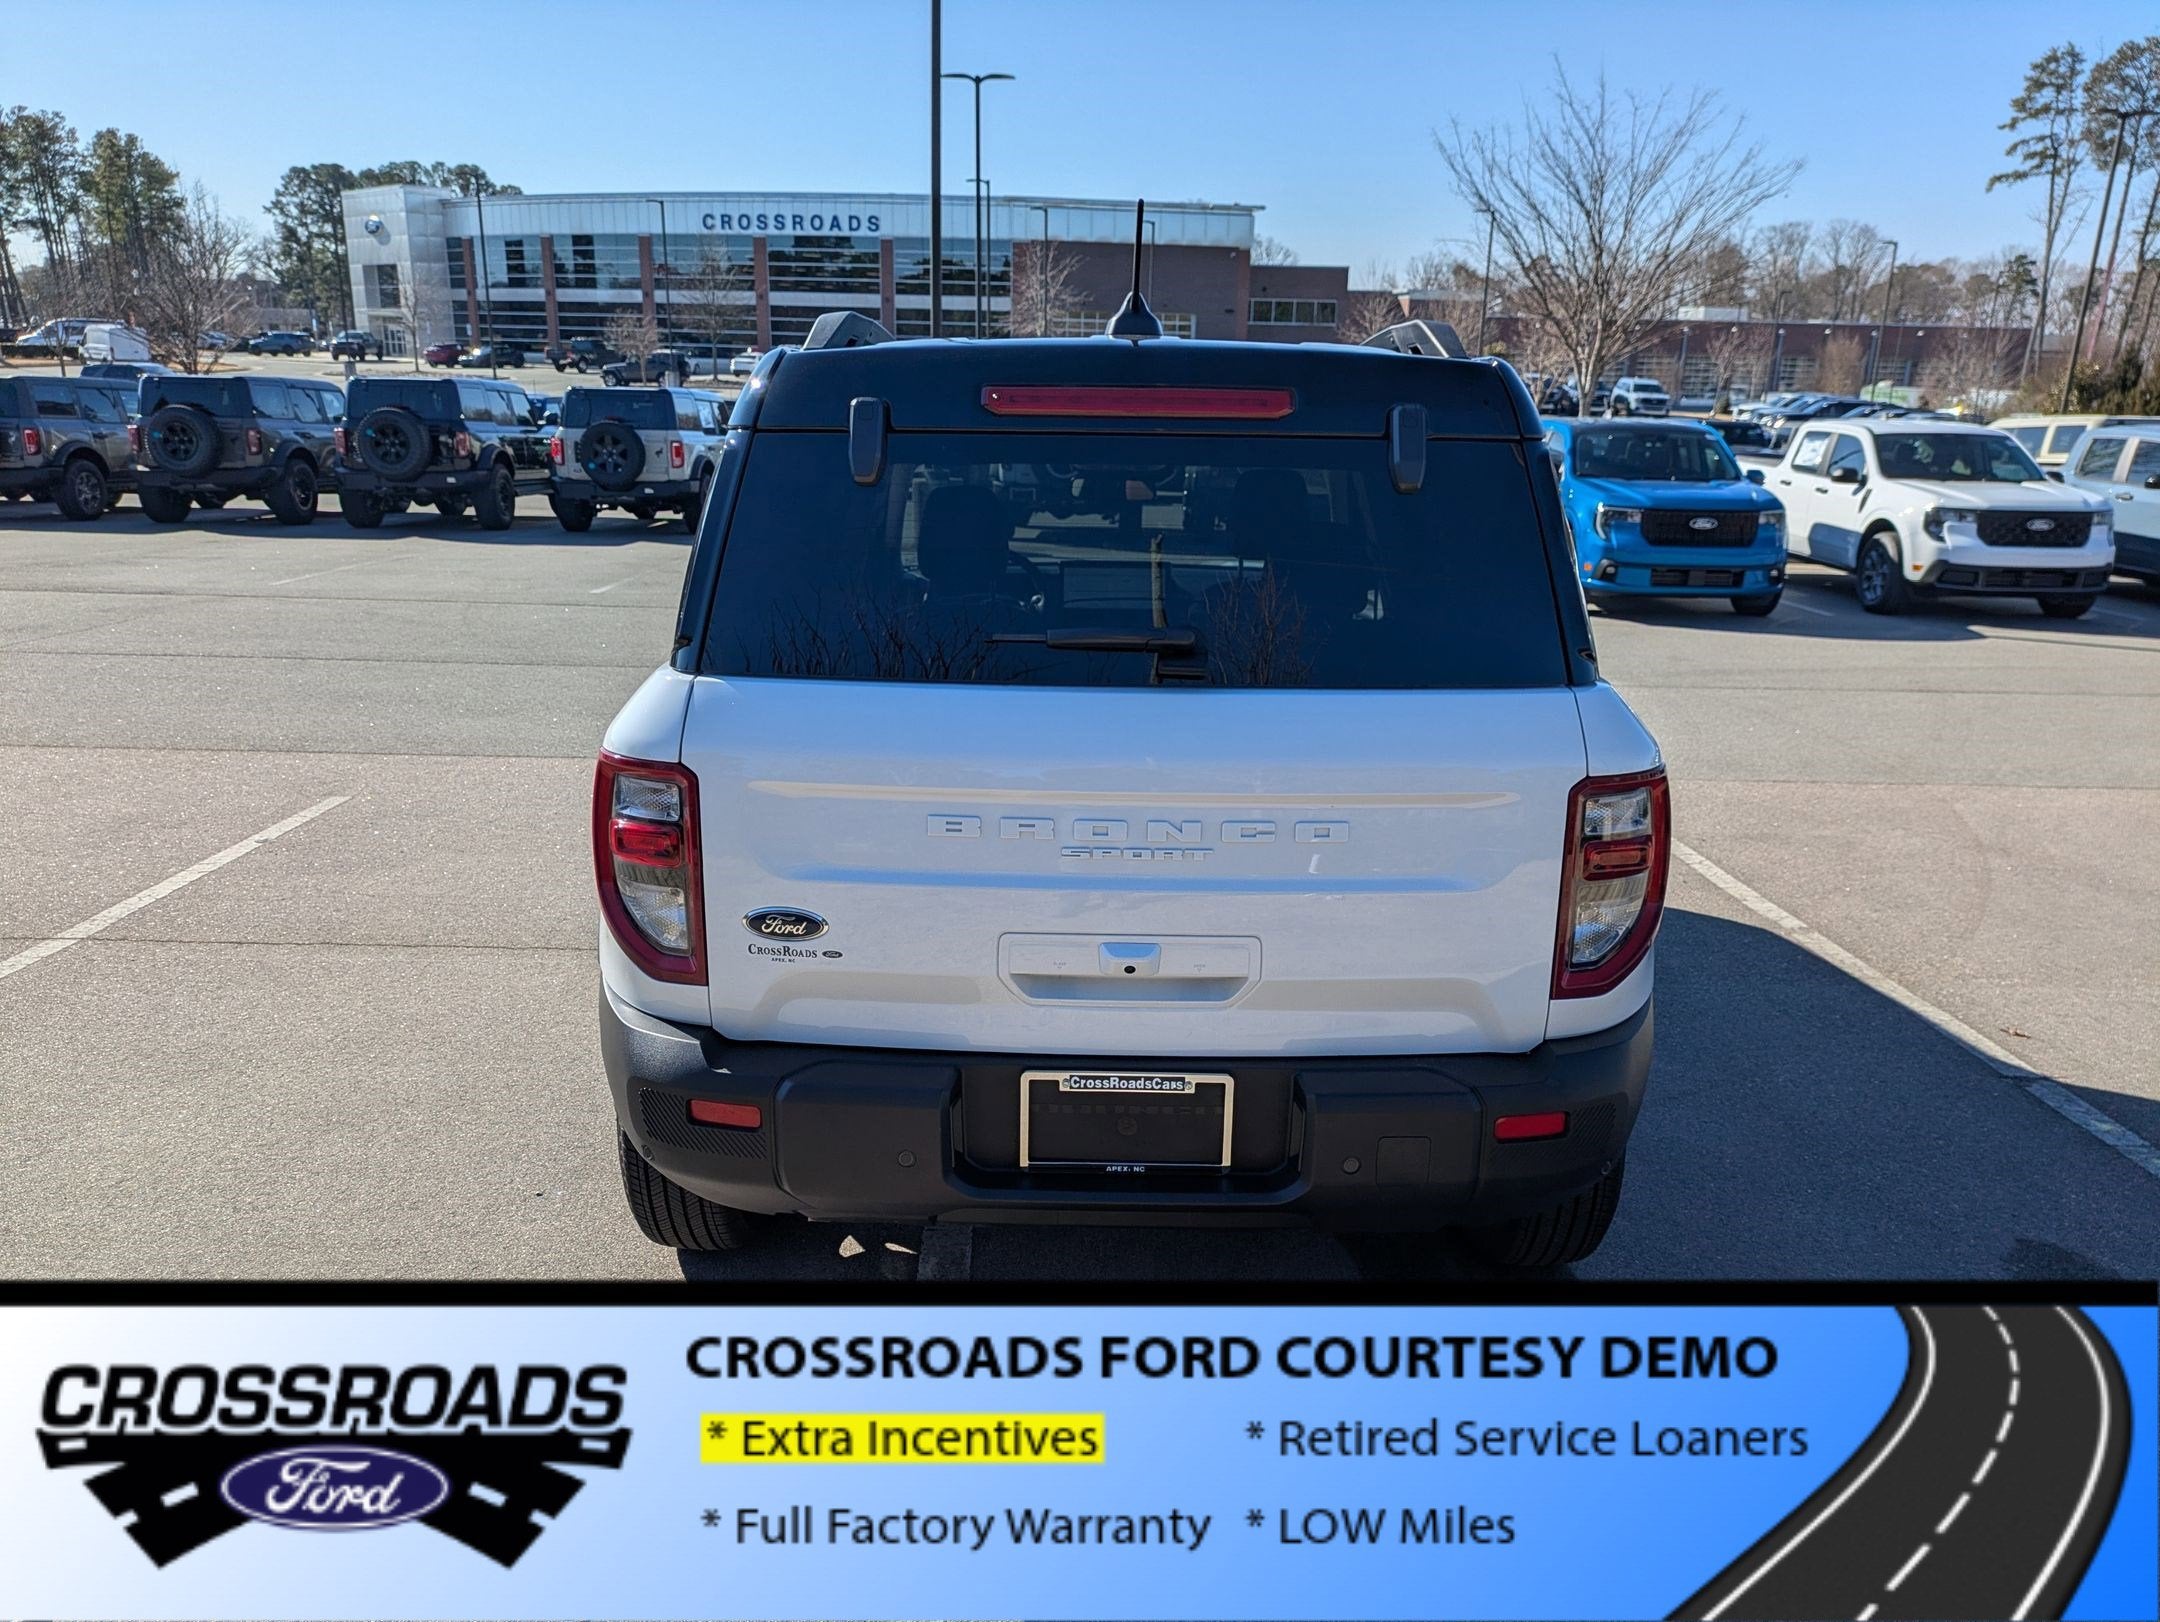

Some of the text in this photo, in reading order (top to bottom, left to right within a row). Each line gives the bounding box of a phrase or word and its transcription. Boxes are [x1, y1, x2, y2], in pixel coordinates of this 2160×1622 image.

[702, 213, 881, 232] CROSSROADS
[927, 813, 1350, 843] BRONCO
[1061, 846, 1214, 861] SPORT
[761, 914, 807, 935] Ford
